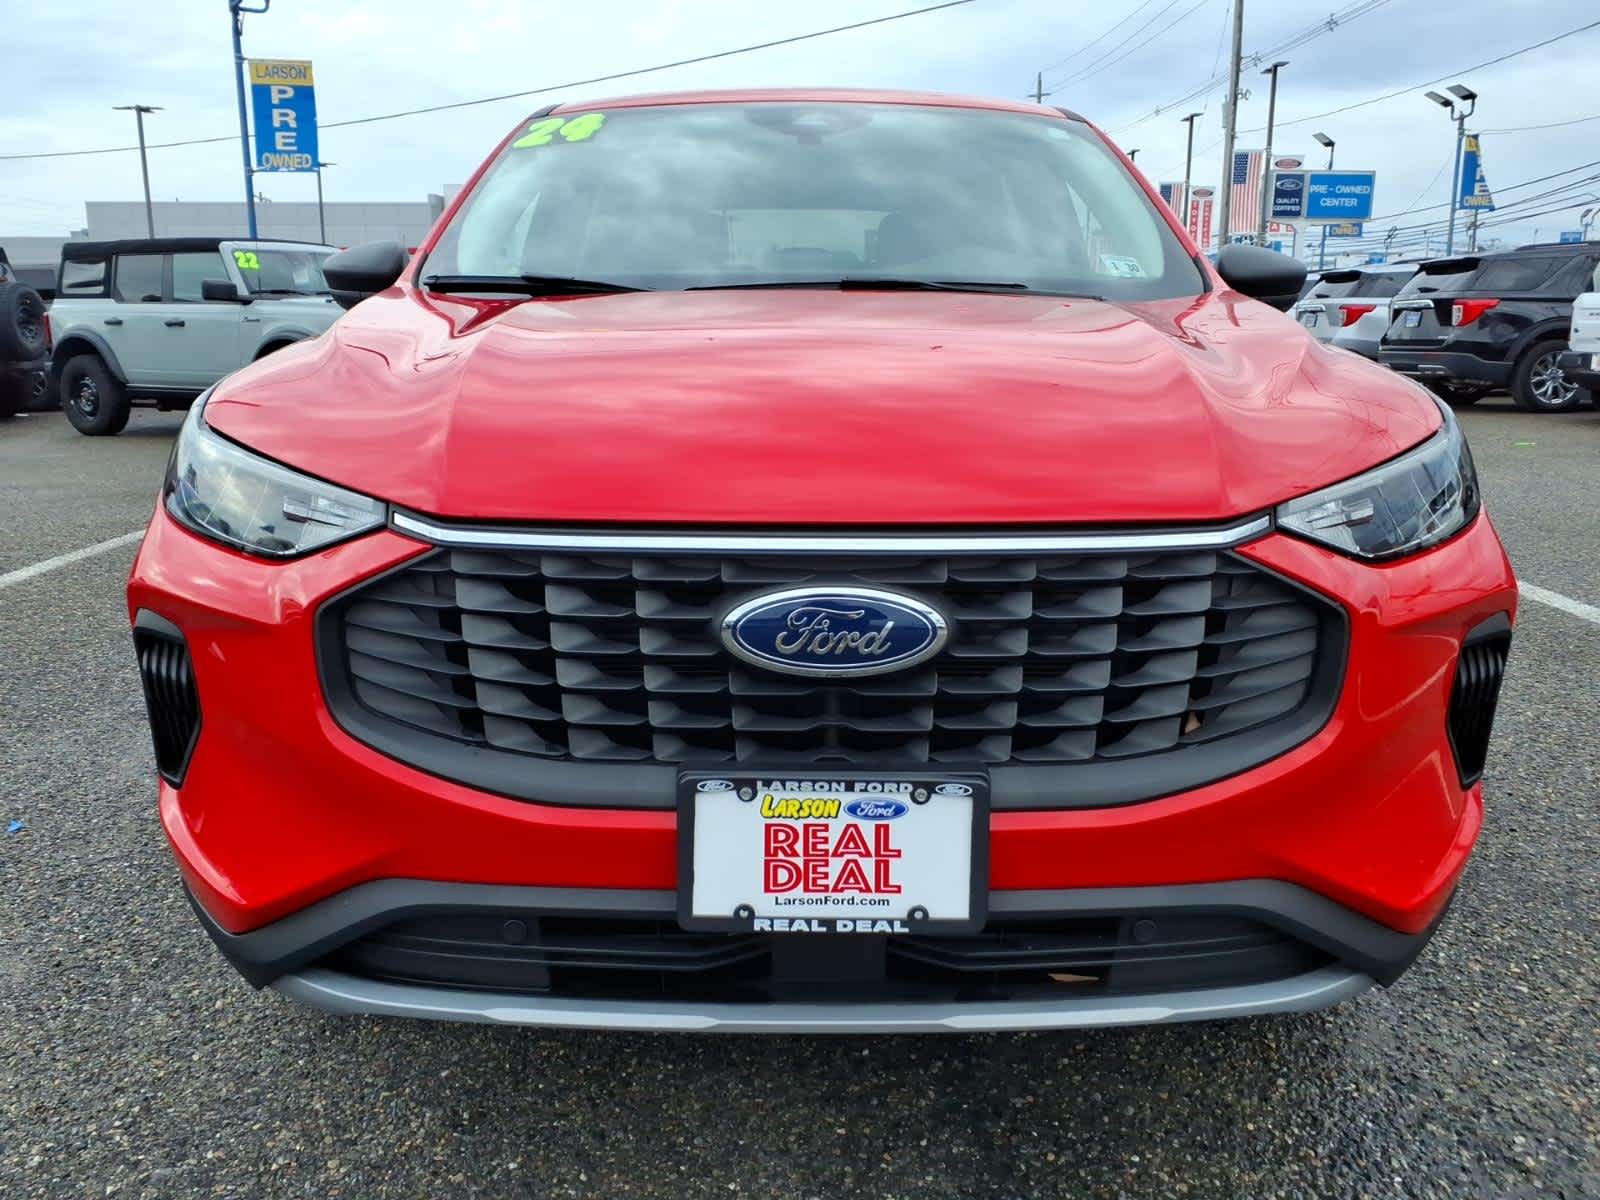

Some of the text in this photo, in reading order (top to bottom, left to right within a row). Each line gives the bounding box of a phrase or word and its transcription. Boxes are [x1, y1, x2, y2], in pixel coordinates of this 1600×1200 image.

[256, 65, 307, 80] LARSON
[270, 86, 298, 151] PRE
[513, 113, 605, 149] 24
[262, 152, 312, 170] OWNED
[1310, 184, 1329, 193] PRE
[1335, 184, 1371, 194] OWNED
[1319, 198, 1358, 207] CENTER
[233, 250, 260, 269] 22
[775, 606, 894, 656] Ford
[756, 780, 914, 794] LARSON FORD
[760, 794, 842, 820] LARSON
[856, 800, 899, 818] Ford
[763, 822, 902, 858] REAL
[763, 858, 902, 894] DEAL
[774, 896, 891, 907] LarsonFord.com
[754, 917, 910, 934] REAL DEAL
